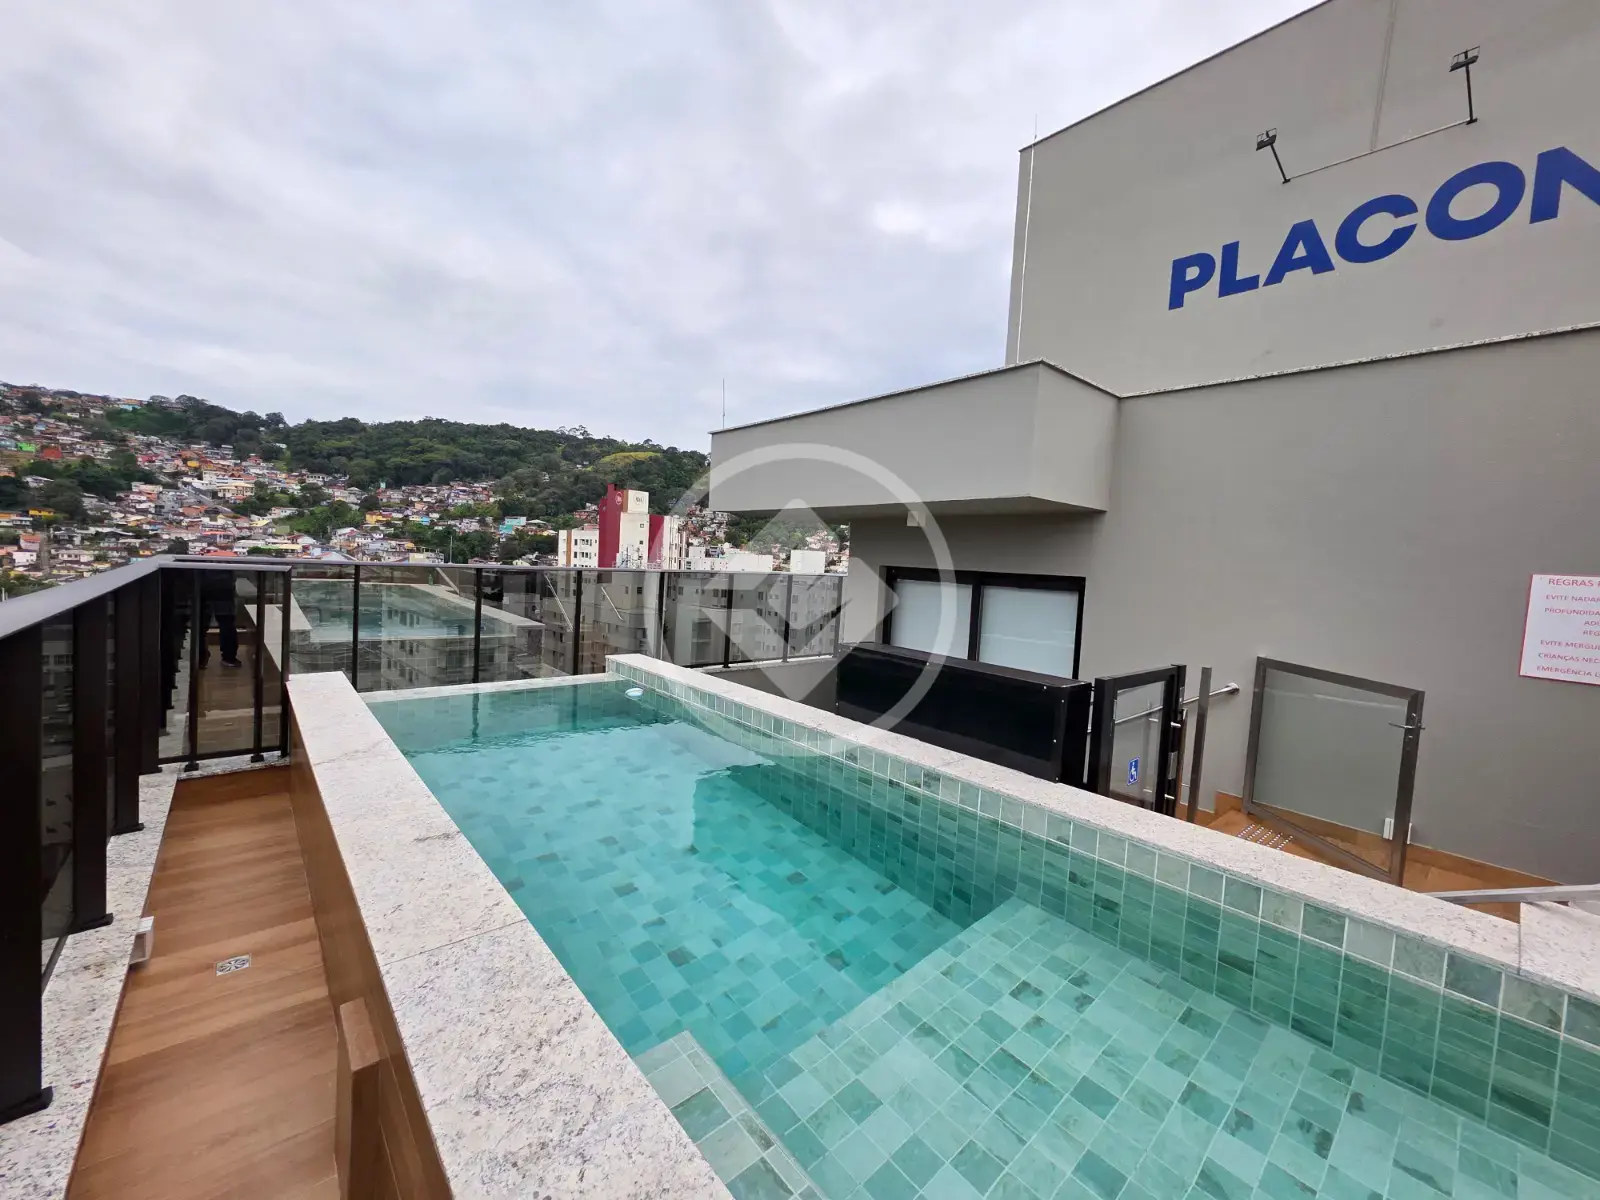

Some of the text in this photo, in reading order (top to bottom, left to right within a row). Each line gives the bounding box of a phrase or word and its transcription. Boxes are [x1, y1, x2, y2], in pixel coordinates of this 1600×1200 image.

[1168, 146, 1600, 310] PLACON
[1548, 579, 1594, 587] REGRAS
[1538, 652, 1580, 662] CRIANÇAS
